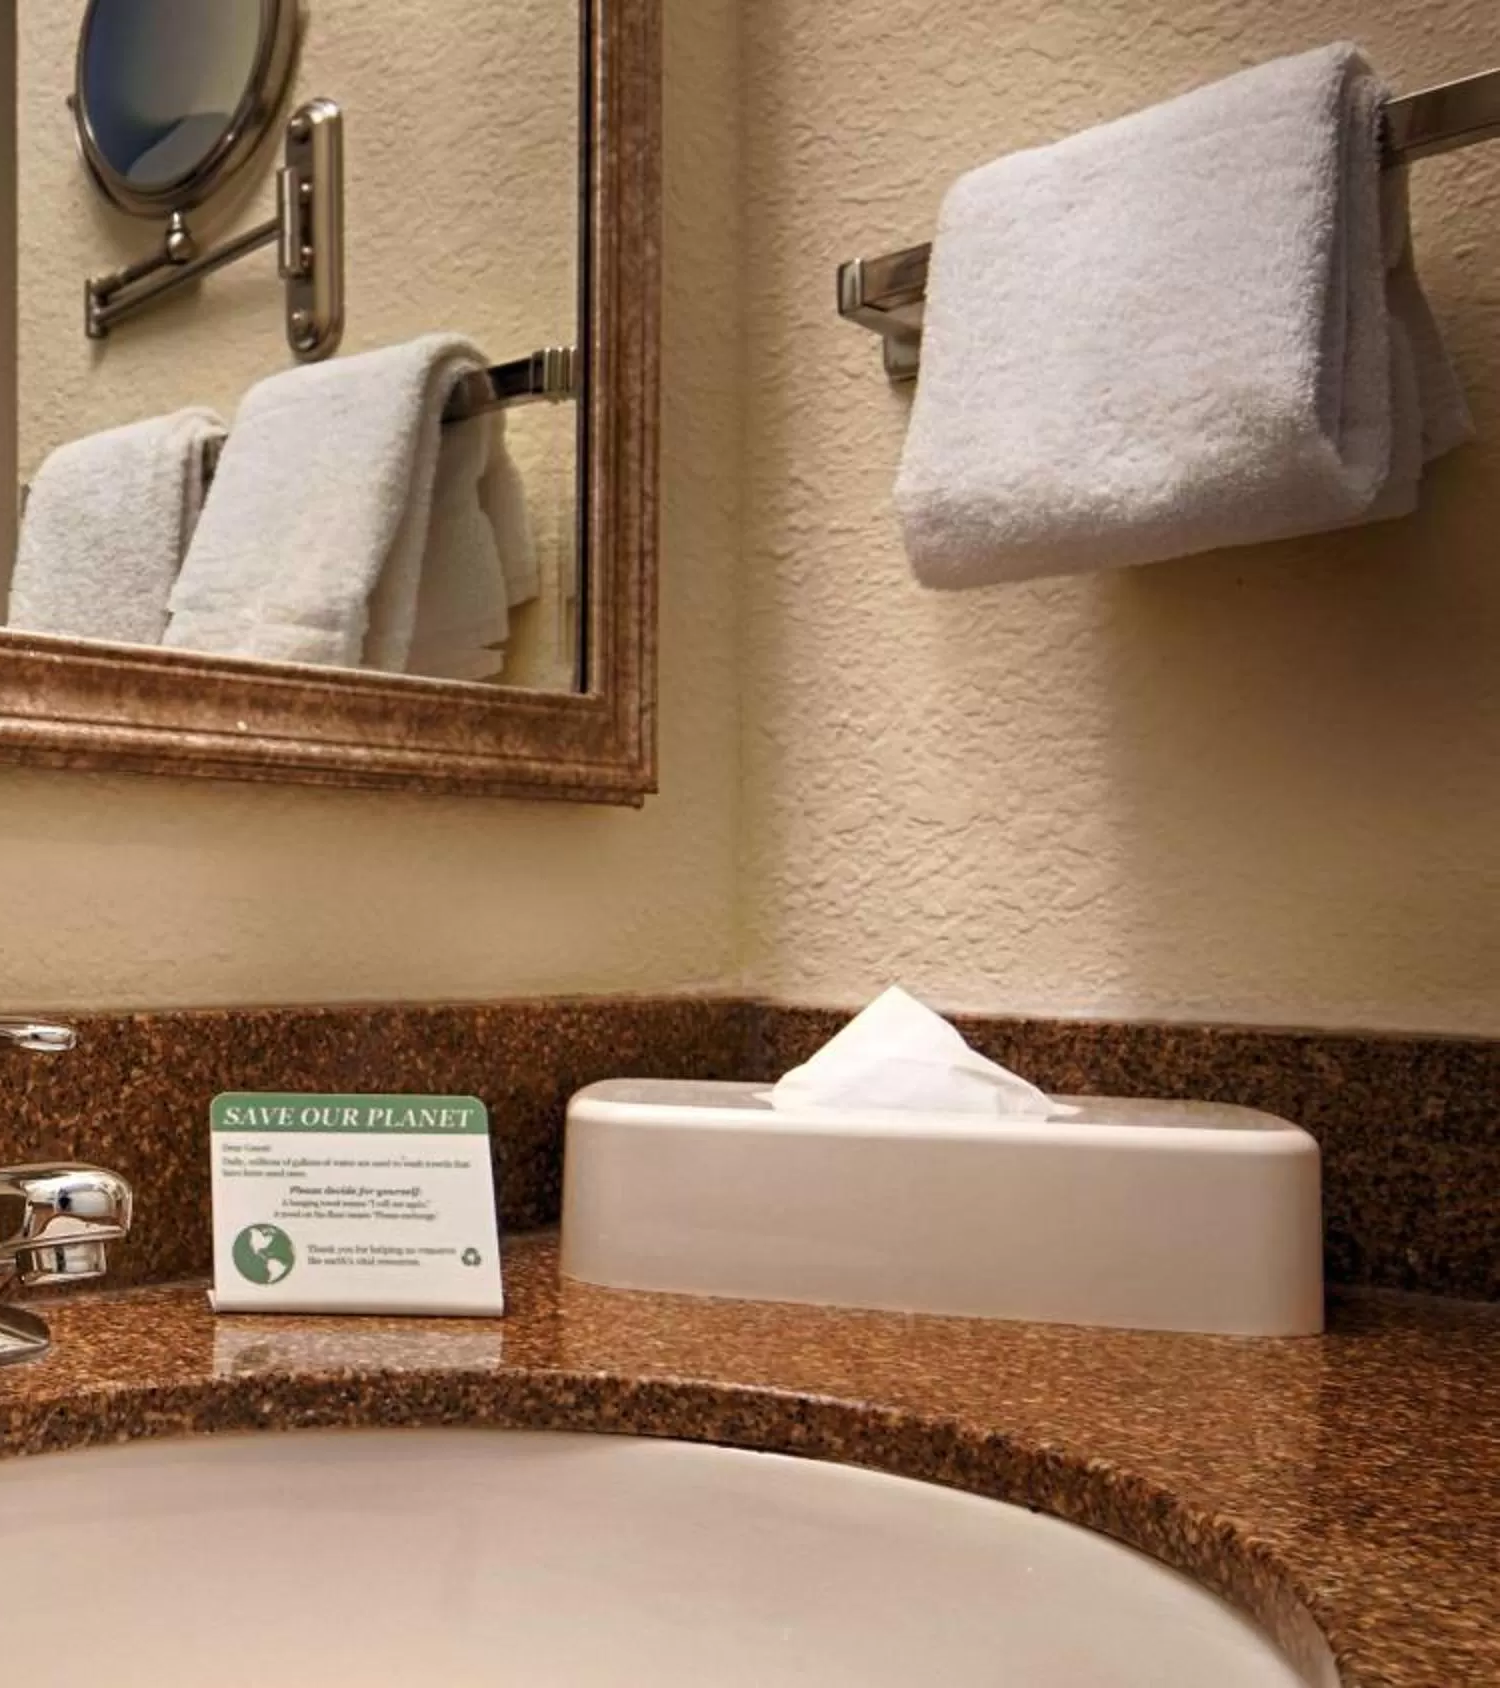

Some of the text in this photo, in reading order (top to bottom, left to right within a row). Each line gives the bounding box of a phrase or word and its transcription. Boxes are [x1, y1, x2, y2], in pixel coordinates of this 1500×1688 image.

[223, 1107, 474, 1128] SAVE OUR PLANET
